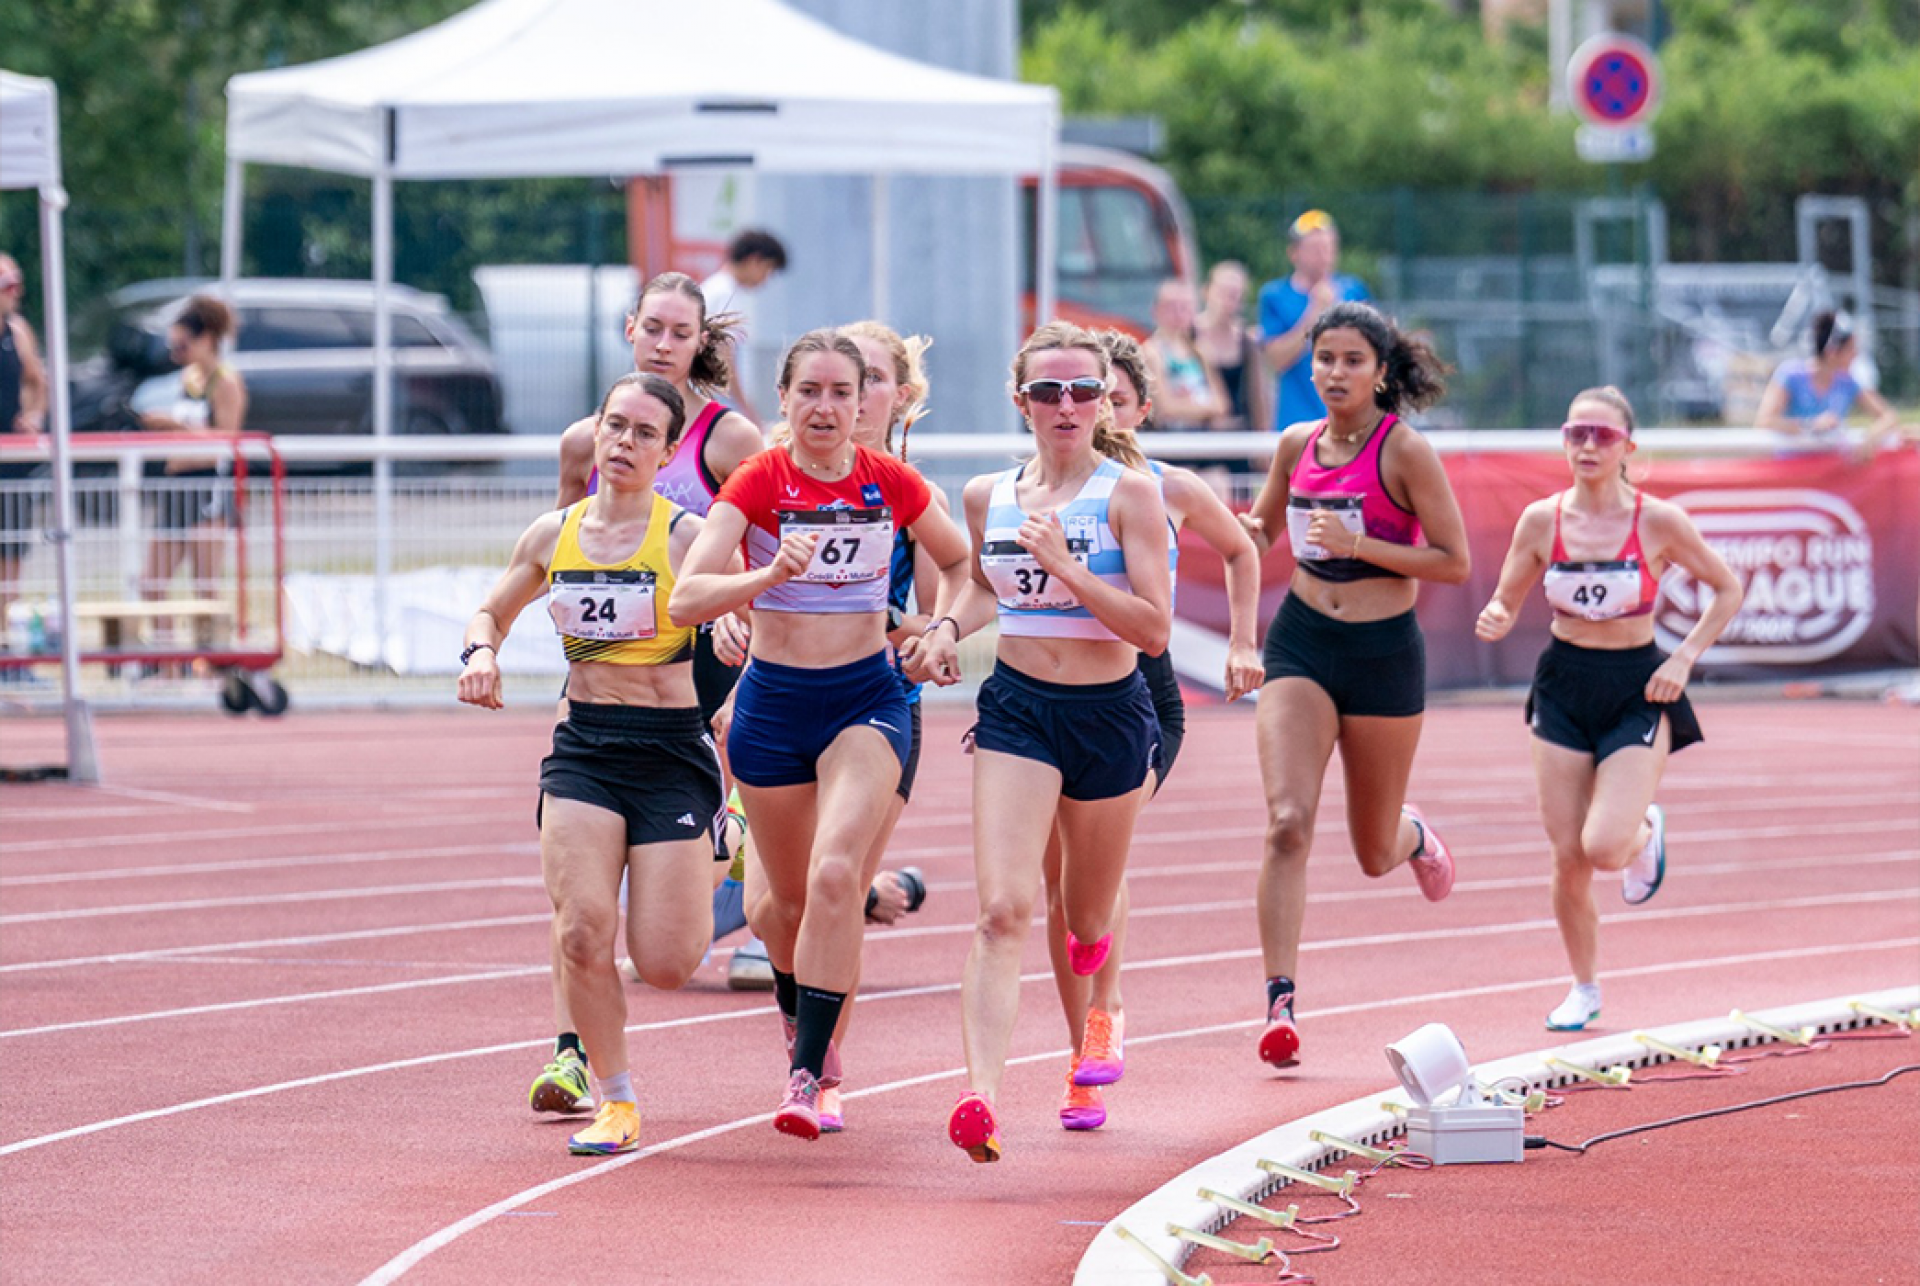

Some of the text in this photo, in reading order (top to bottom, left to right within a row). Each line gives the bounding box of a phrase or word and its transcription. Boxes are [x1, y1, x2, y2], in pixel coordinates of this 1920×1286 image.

[821, 538, 860, 564] 67
[1014, 568, 1050, 595] 37
[1573, 584, 1607, 606] 49
[579, 597, 617, 623] 24
